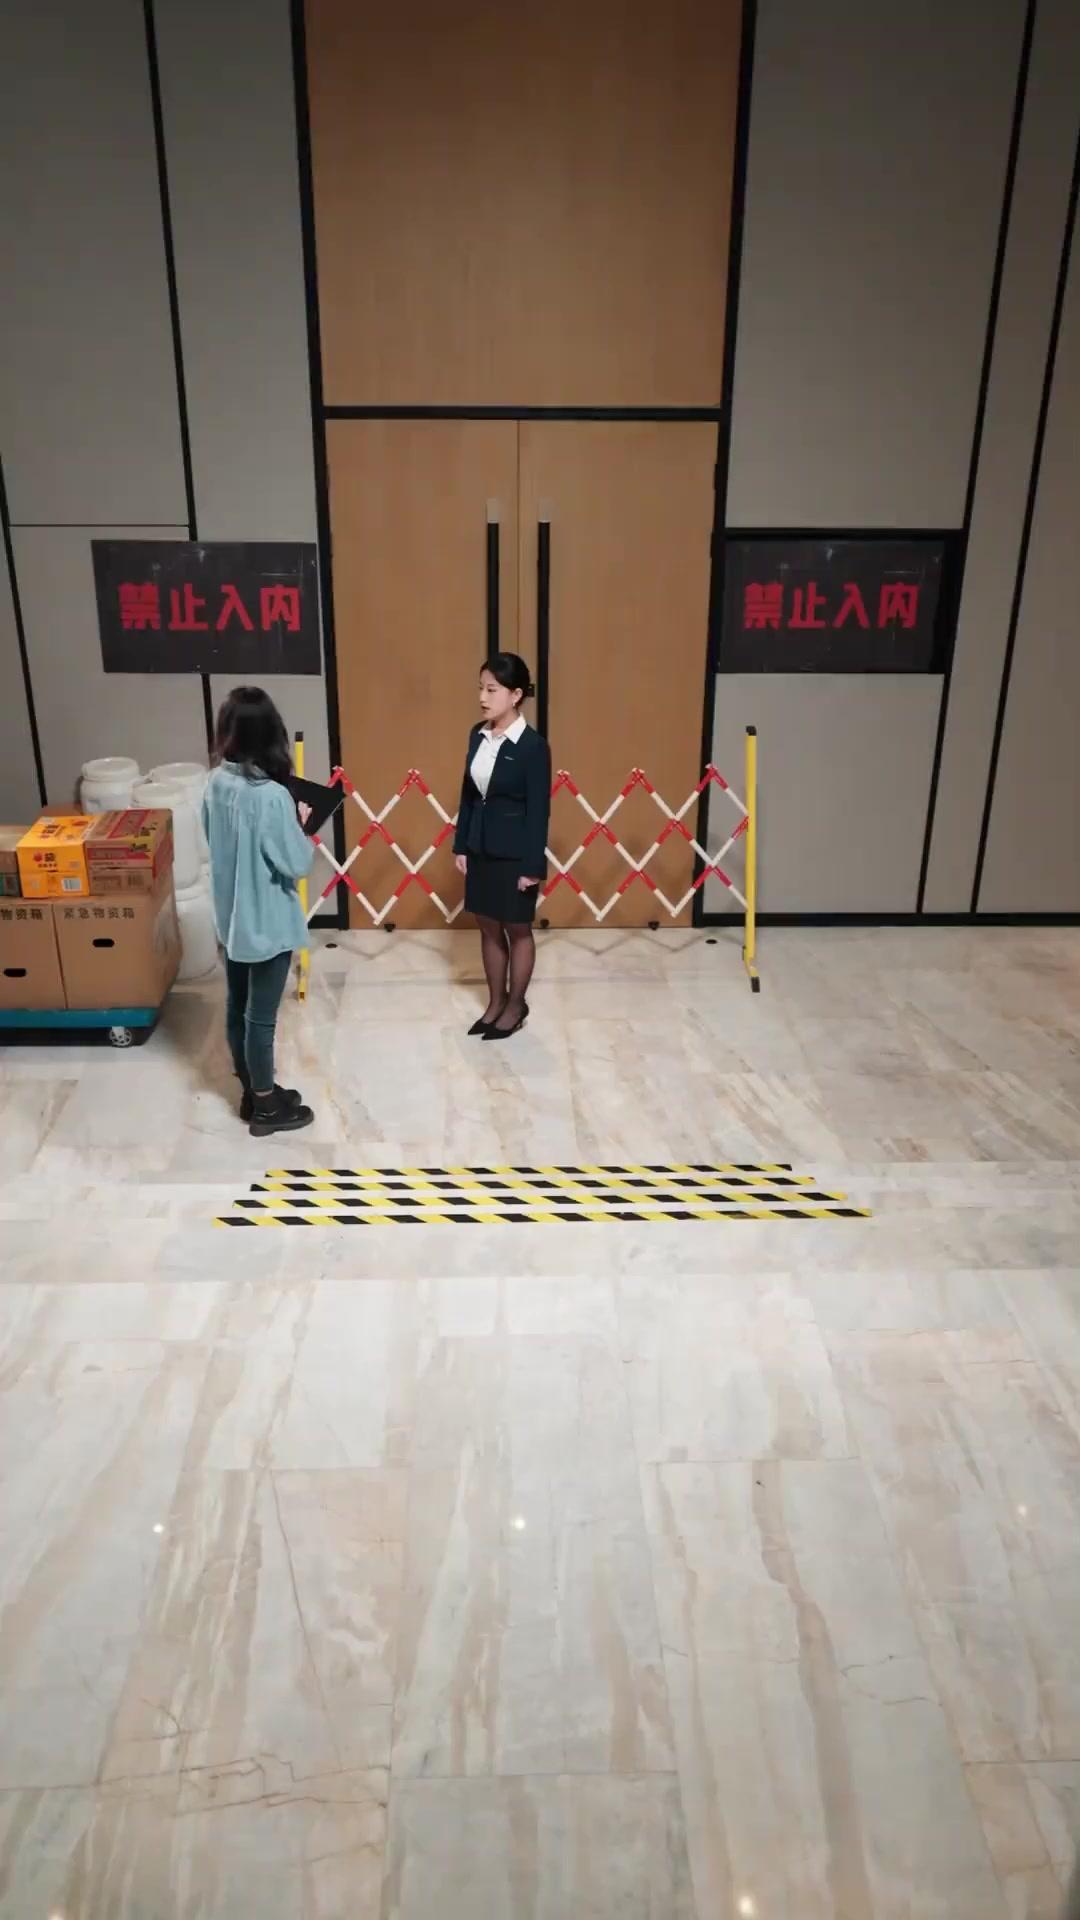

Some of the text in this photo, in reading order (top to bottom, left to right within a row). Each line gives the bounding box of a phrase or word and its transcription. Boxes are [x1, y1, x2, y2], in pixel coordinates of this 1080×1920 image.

[118, 582, 301, 632] 禁止入内
[743, 581, 920, 630] 禁止入内
[63, 906, 135, 920] 紧急物资箱
